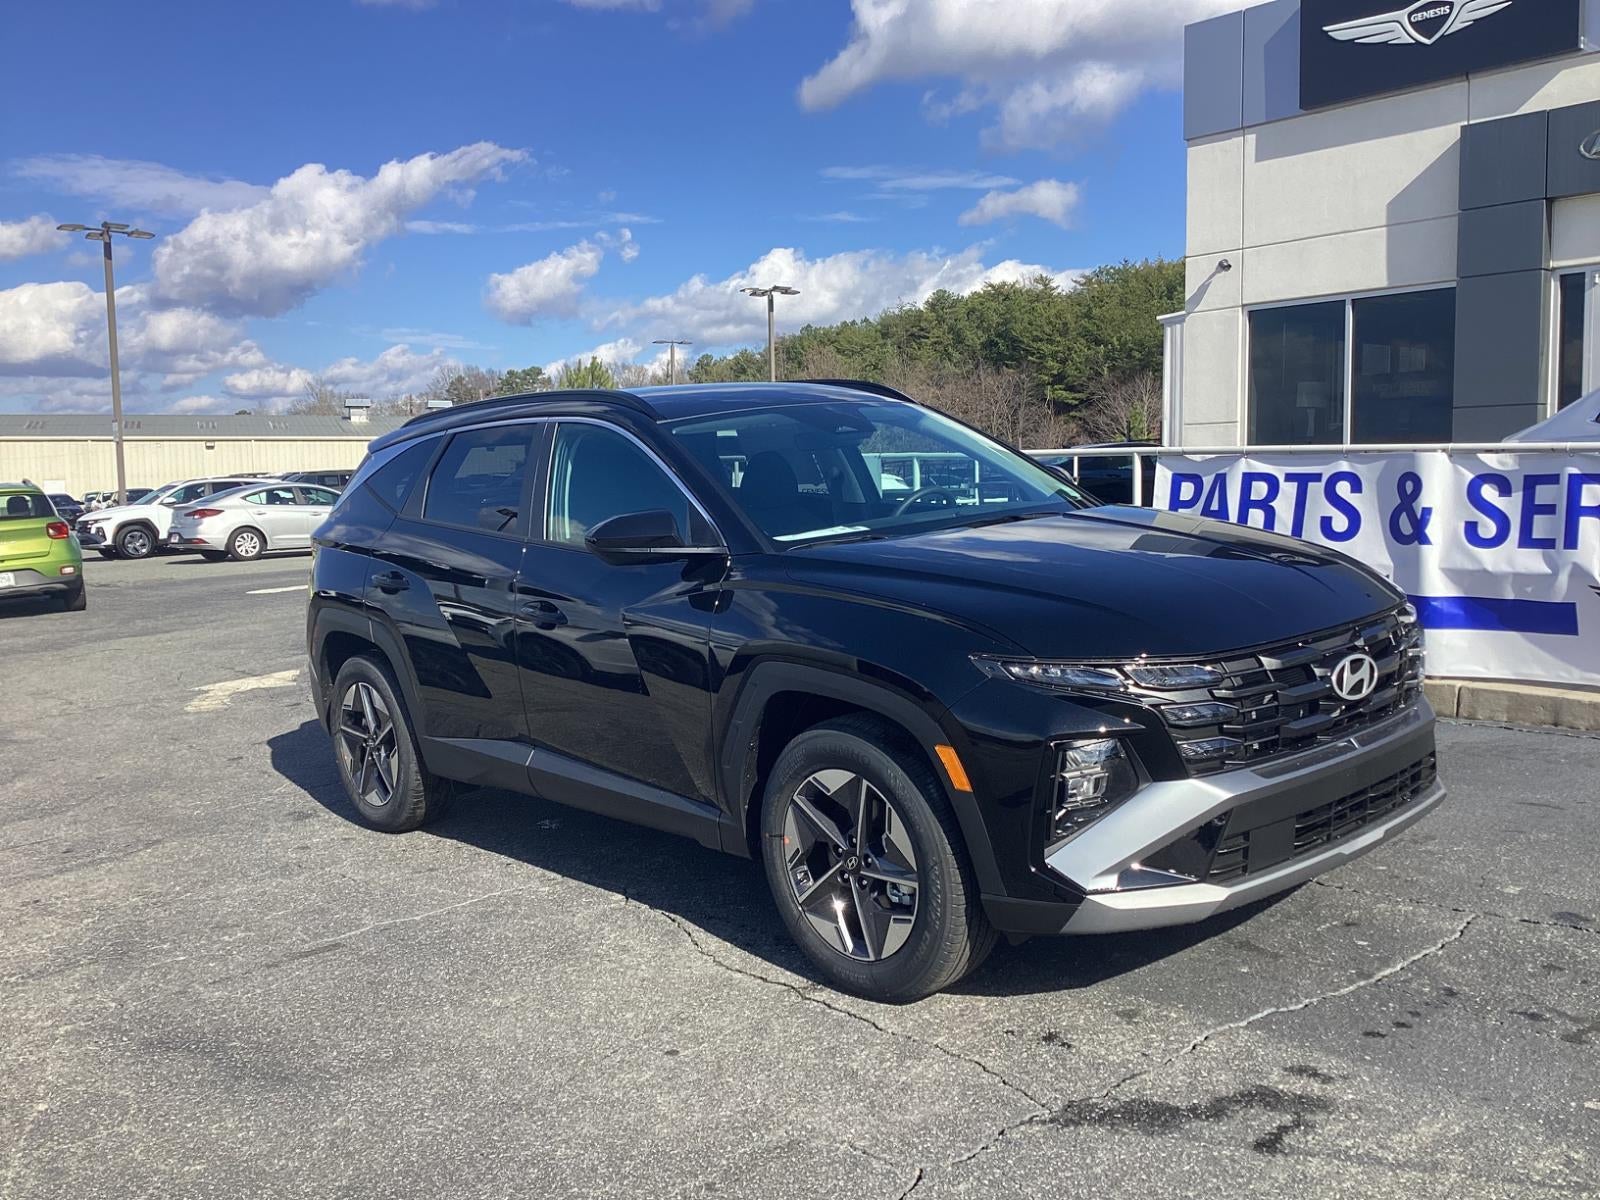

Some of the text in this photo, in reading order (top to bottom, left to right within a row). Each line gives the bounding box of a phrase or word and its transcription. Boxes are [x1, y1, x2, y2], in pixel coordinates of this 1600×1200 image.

[1410, 5, 1450, 23] GENESIS
[1168, 471, 1363, 543] PARTS
[1389, 471, 1433, 546] &
